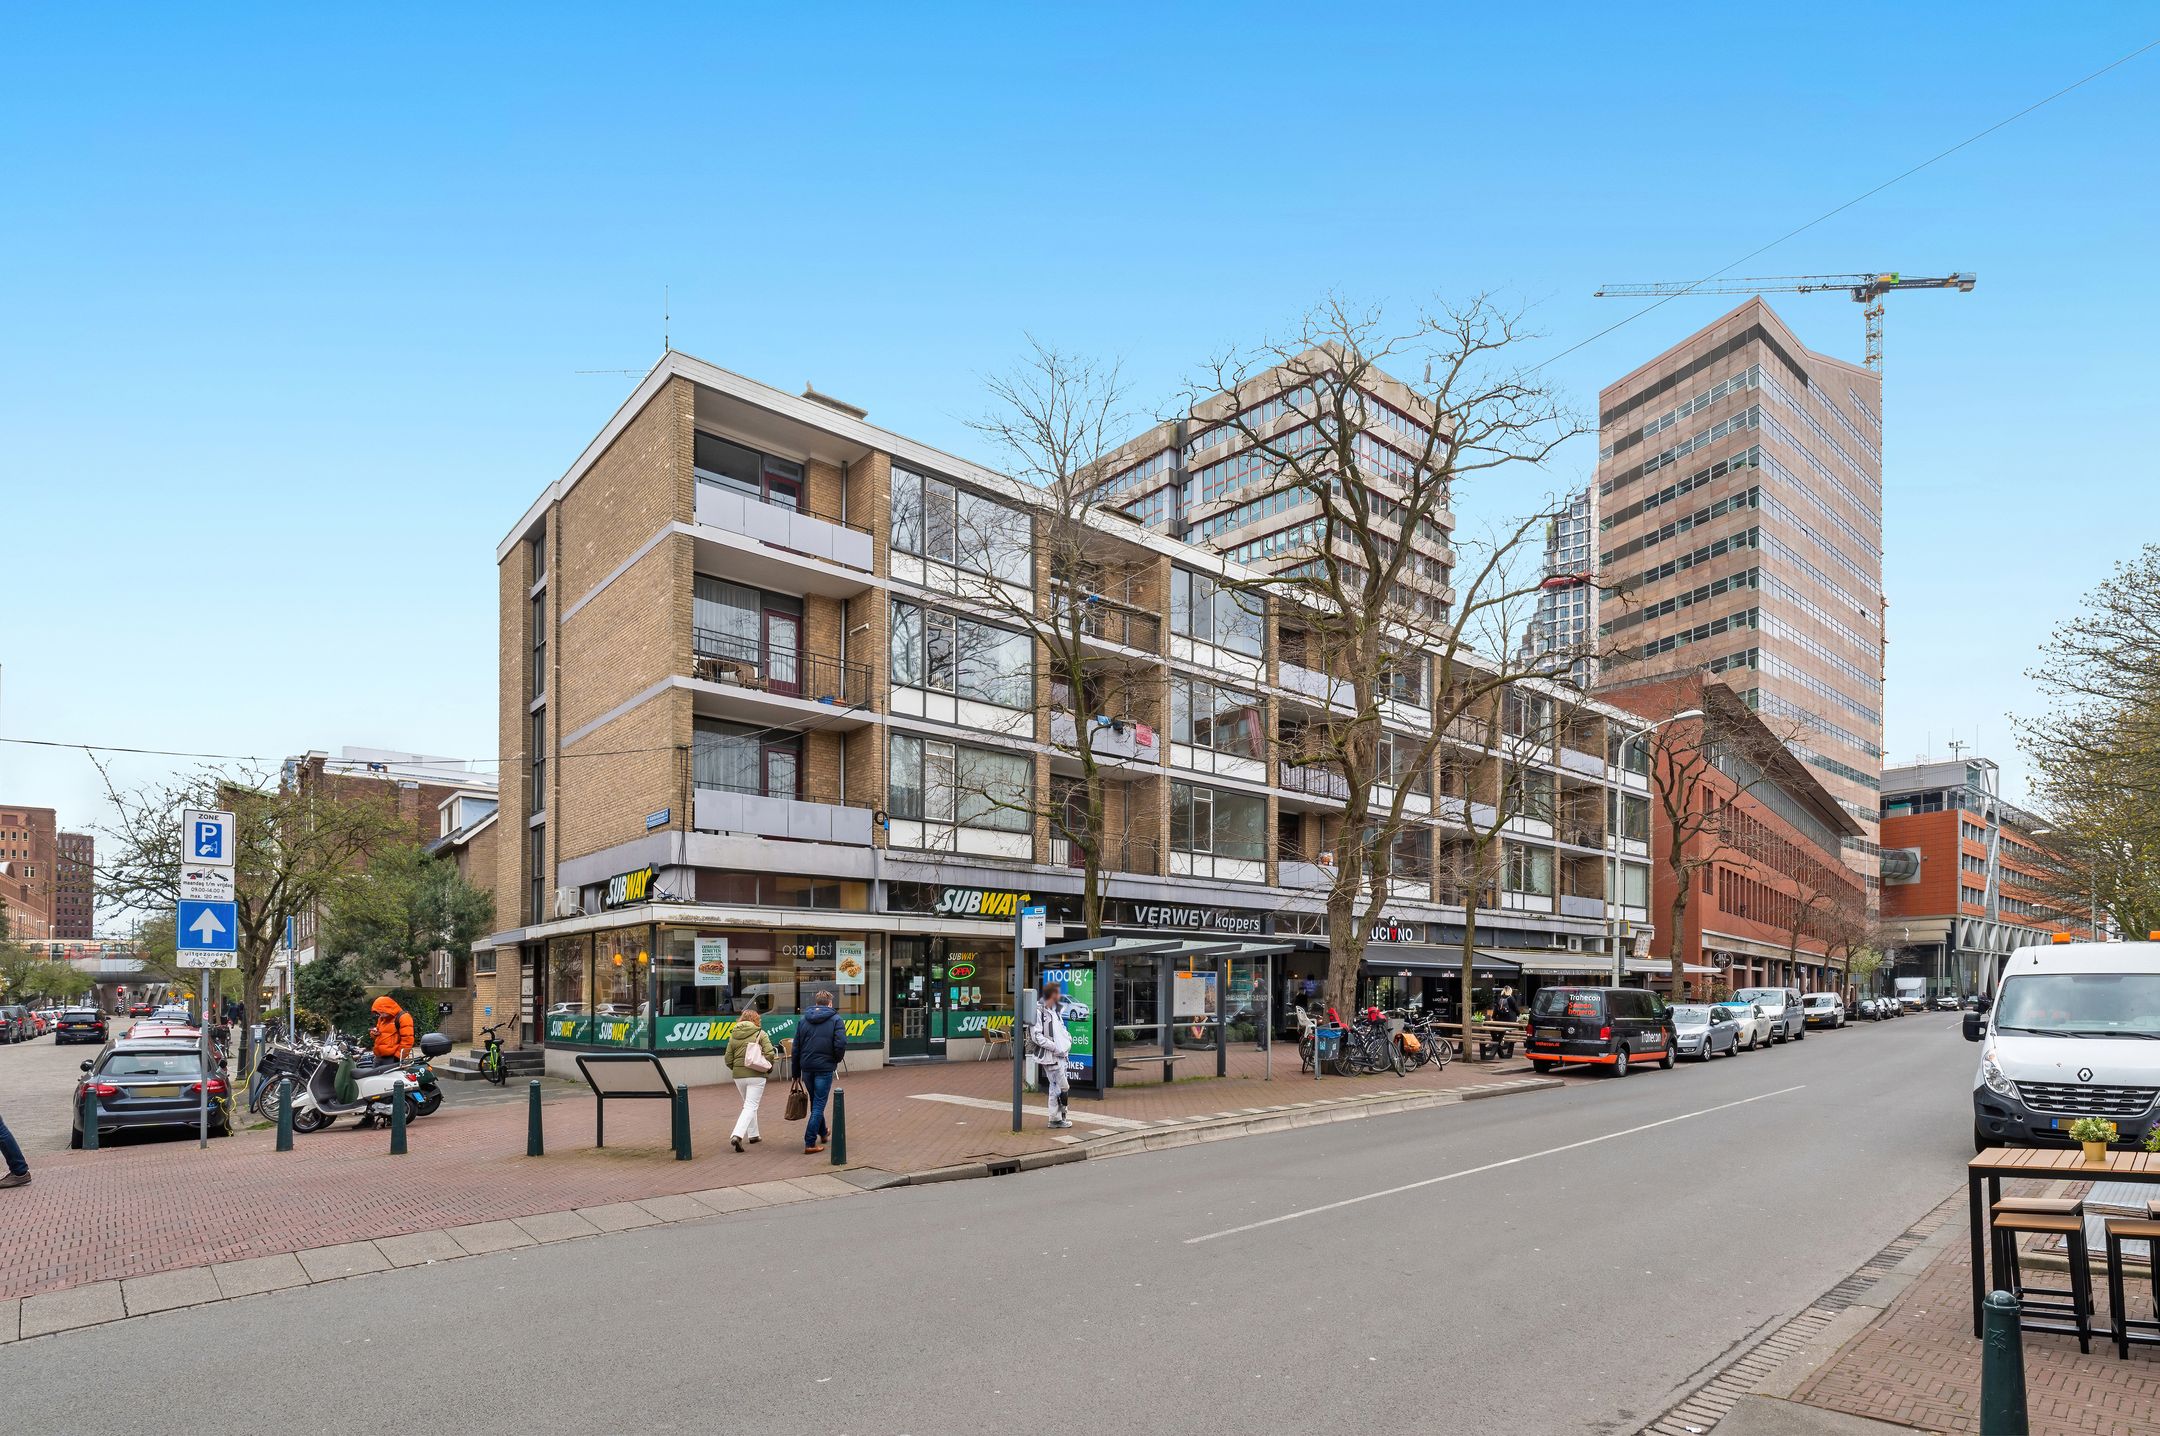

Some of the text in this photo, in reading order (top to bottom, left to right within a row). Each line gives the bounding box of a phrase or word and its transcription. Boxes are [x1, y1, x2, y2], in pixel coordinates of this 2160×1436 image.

[198, 813, 220, 821] ZONE
[201, 824, 217, 843] P
[606, 867, 653, 905] SUBWAY
[936, 889, 1031, 916] SUBWAY
[1135, 905, 1260, 932] VERWEY kappers
[1369, 926, 1413, 941] UCIANO
[948, 953, 979, 961] SUBWAY
[952, 966, 973, 976] OPEN
[1047, 969, 1090, 986] nodig?
[551, 1020, 576, 1038] SUBWAY
[599, 1022, 630, 1041] SUBWAY
[665, 1022, 736, 1042] SUBWA
[772, 1019, 793, 1034] fresh
[1641, 1030, 1661, 1043] Trahecon
